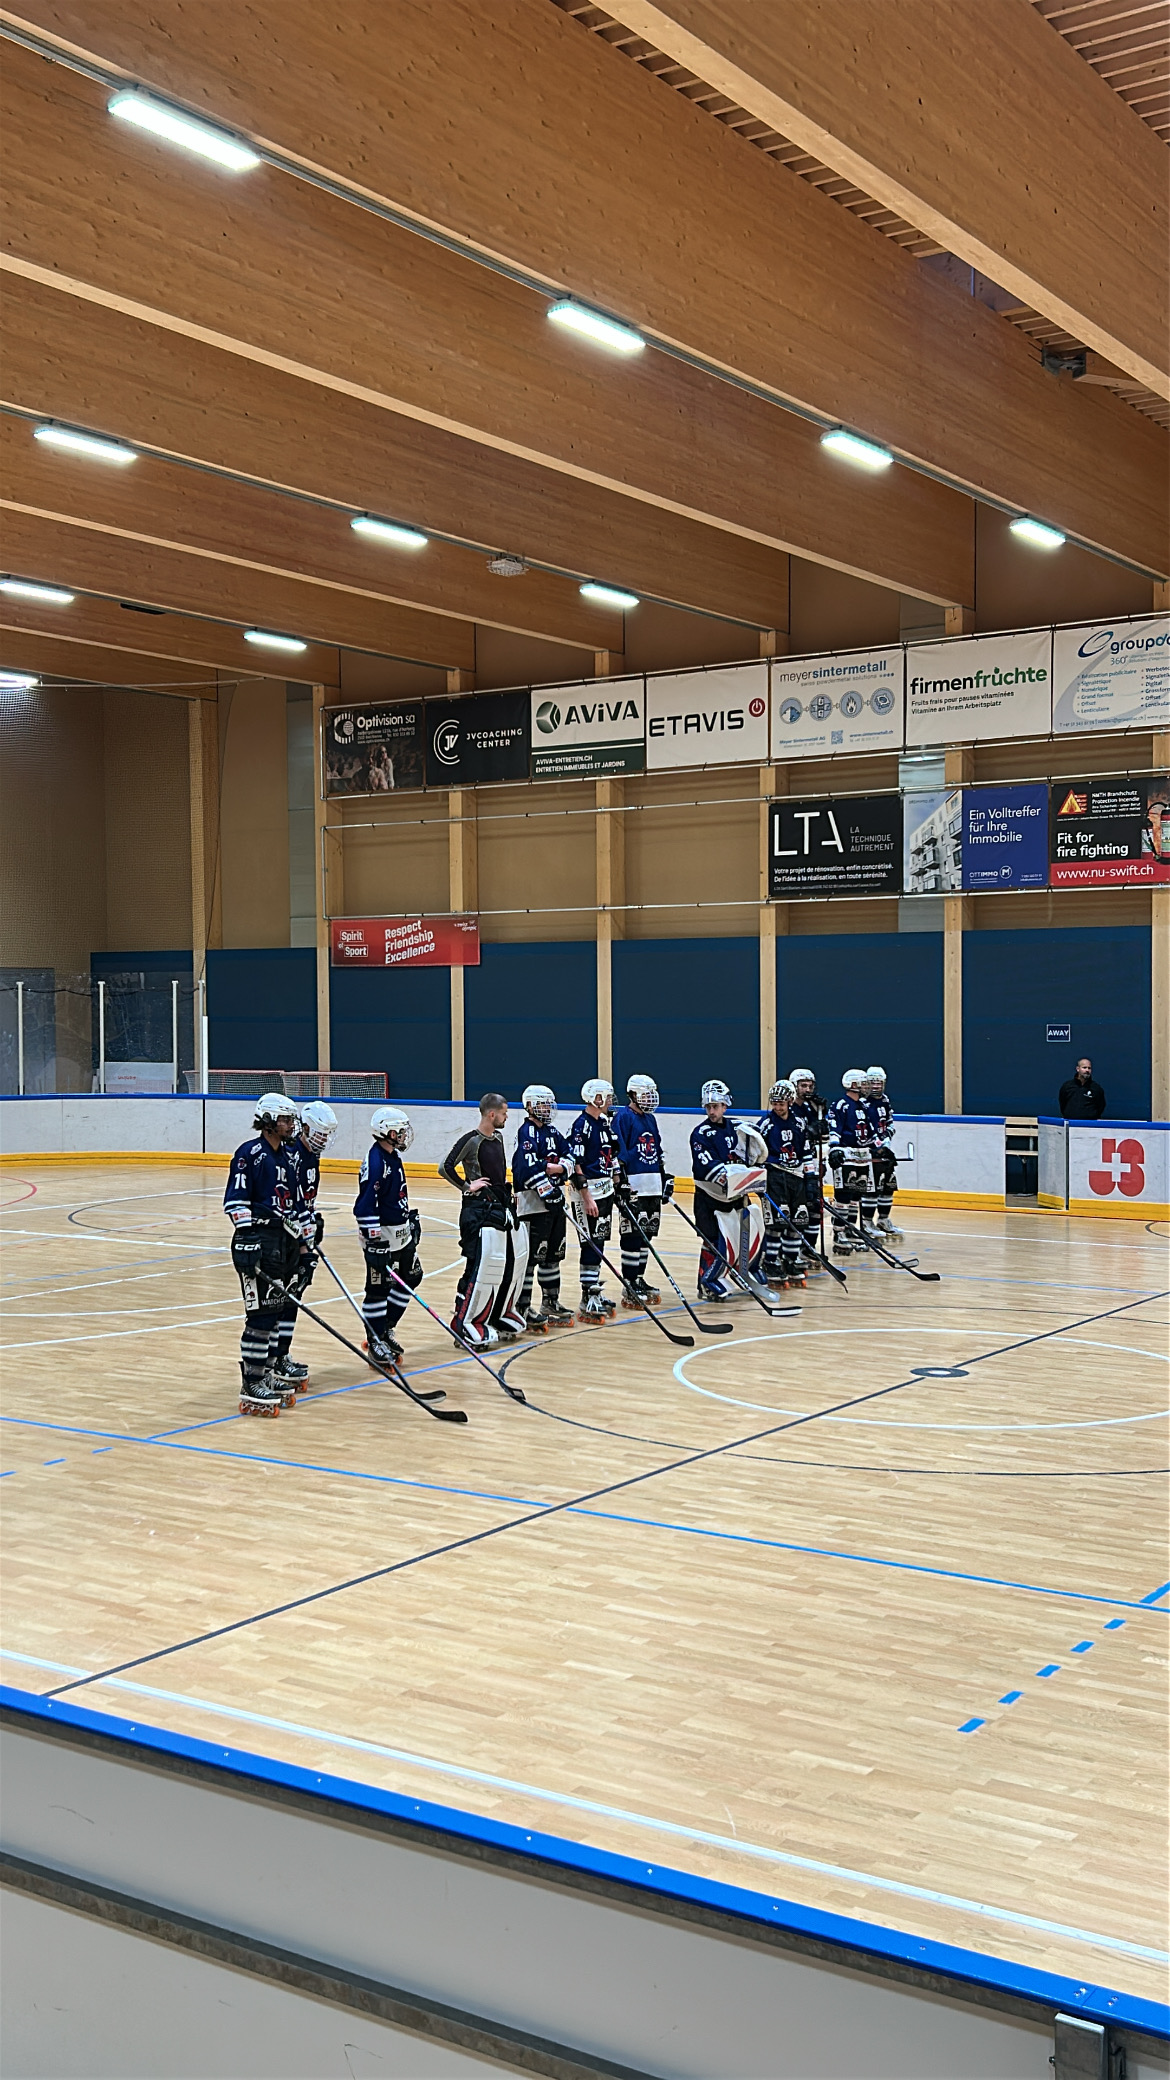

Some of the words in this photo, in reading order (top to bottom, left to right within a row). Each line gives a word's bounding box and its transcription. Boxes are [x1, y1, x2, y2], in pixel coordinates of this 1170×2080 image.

[780, 660, 886, 683] meyersintermetall
[958, 694, 980, 702] pauses
[912, 706, 938, 714] Vitamine
[946, 704, 964, 712] Ihrem
[964, 700, 1002, 710] Arbeitsplatz
[357, 713, 403, 730] Optivision
[406, 714, 416, 724] sa
[649, 709, 744, 737] ETAVIS
[466, 728, 522, 740] JVCOACHING
[476, 739, 510, 748] CENTER
[536, 765, 564, 774] ENTRETIEN
[564, 762, 594, 771] IMMEUBLES
[601, 760, 626, 769] JARDINS
[969, 810, 986, 820] Ein
[988, 805, 1041, 819] Volltreffer
[850, 826, 860, 834] LA
[968, 822, 984, 832] für
[987, 821, 1008, 832] Ihre
[774, 810, 844, 856] LTA
[850, 834, 892, 843] TECHNIQUE
[969, 832, 1022, 844] Immobilie
[1057, 832, 1072, 844] Fit
[1076, 832, 1094, 843] for
[850, 843, 894, 852] AUTREMENT
[1056, 845, 1077, 858] fire
[1080, 842, 1128, 858] fighting
[790, 867, 806, 875] projet
[969, 870, 998, 878] OTTIMMO
[1057, 864, 1154, 879] www.nu-swift.ch
[384, 920, 422, 940] Respect
[341, 931, 363, 942] Spirit
[385, 930, 434, 952] Friendship
[345, 946, 366, 957] Sport
[385, 942, 436, 964] Excellence
[724, 1136, 734, 1148] 31
[780, 1130, 793, 1142] 89
[546, 1136, 556, 1150] 24
[698, 1150, 713, 1165] 31
